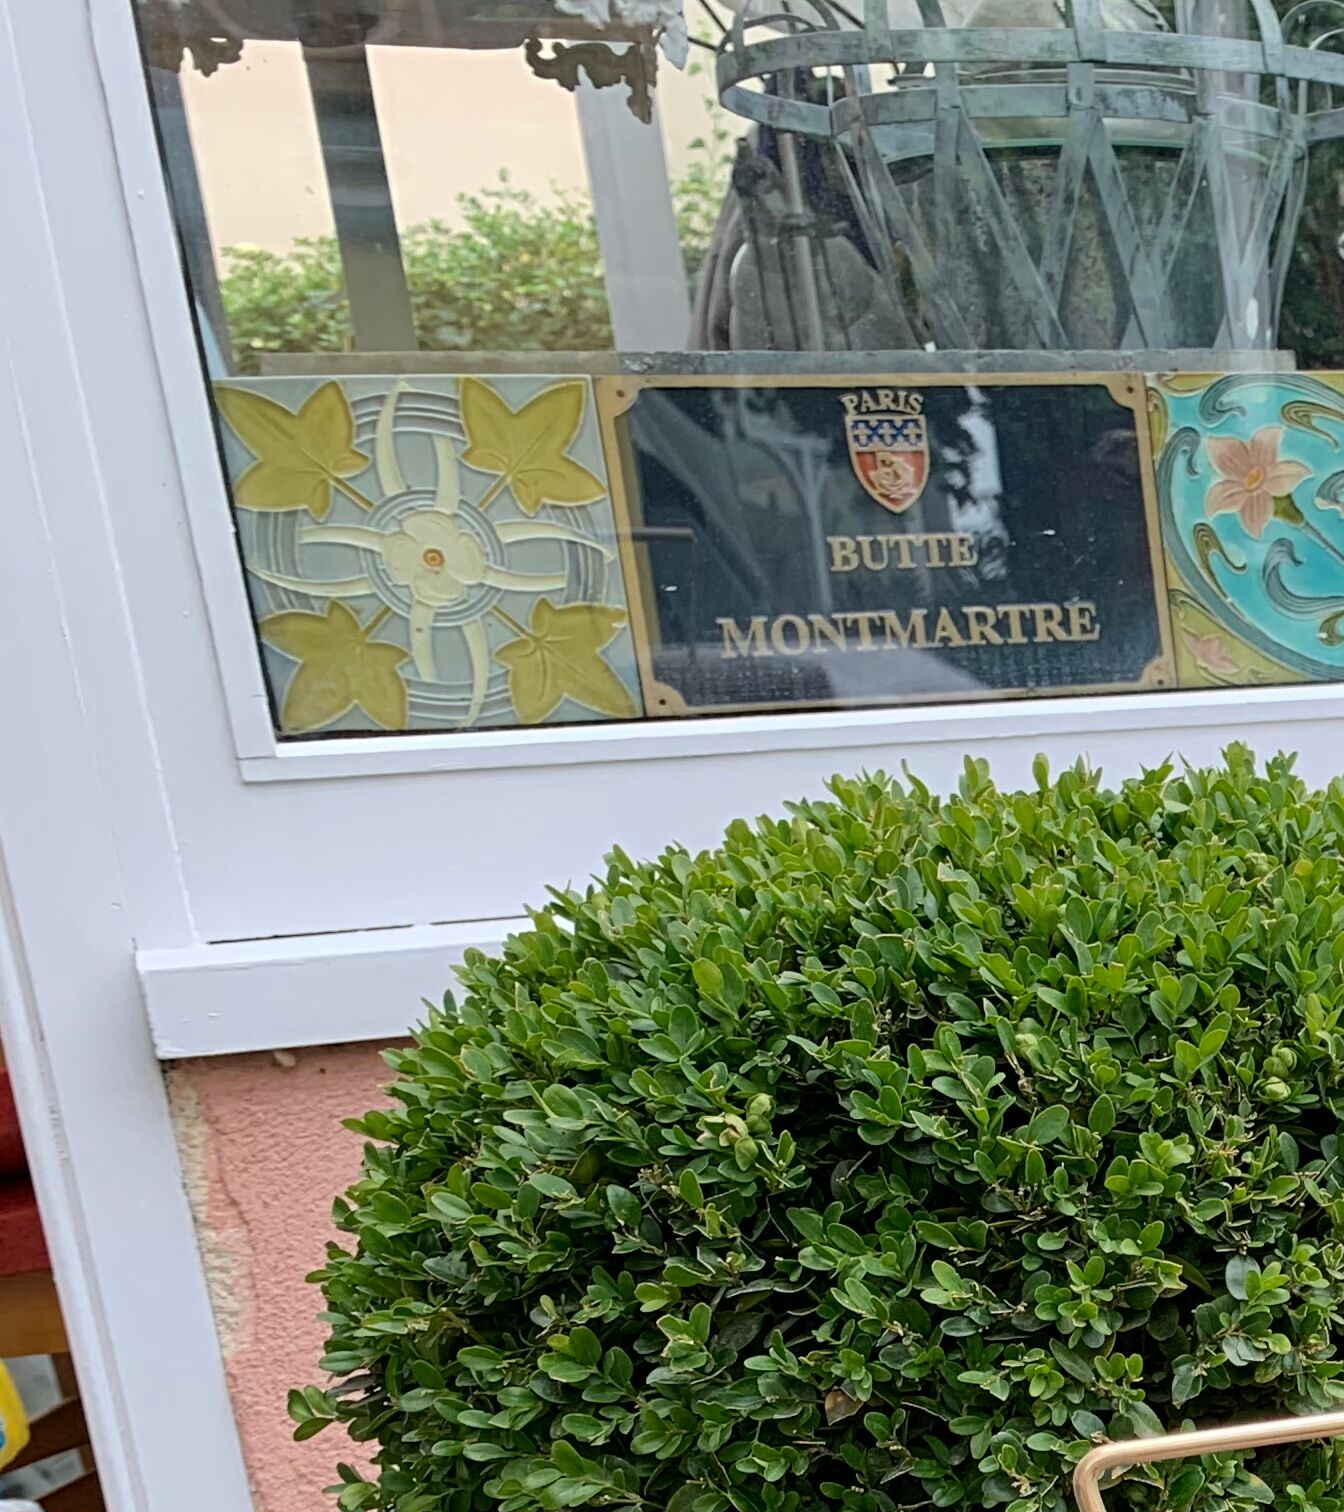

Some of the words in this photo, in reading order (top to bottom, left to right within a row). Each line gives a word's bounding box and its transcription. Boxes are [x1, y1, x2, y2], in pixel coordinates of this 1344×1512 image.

[841, 388, 925, 416] PARIS
[827, 534, 977, 573] BUTTE
[716, 602, 1101, 660] MONTMARTRE
